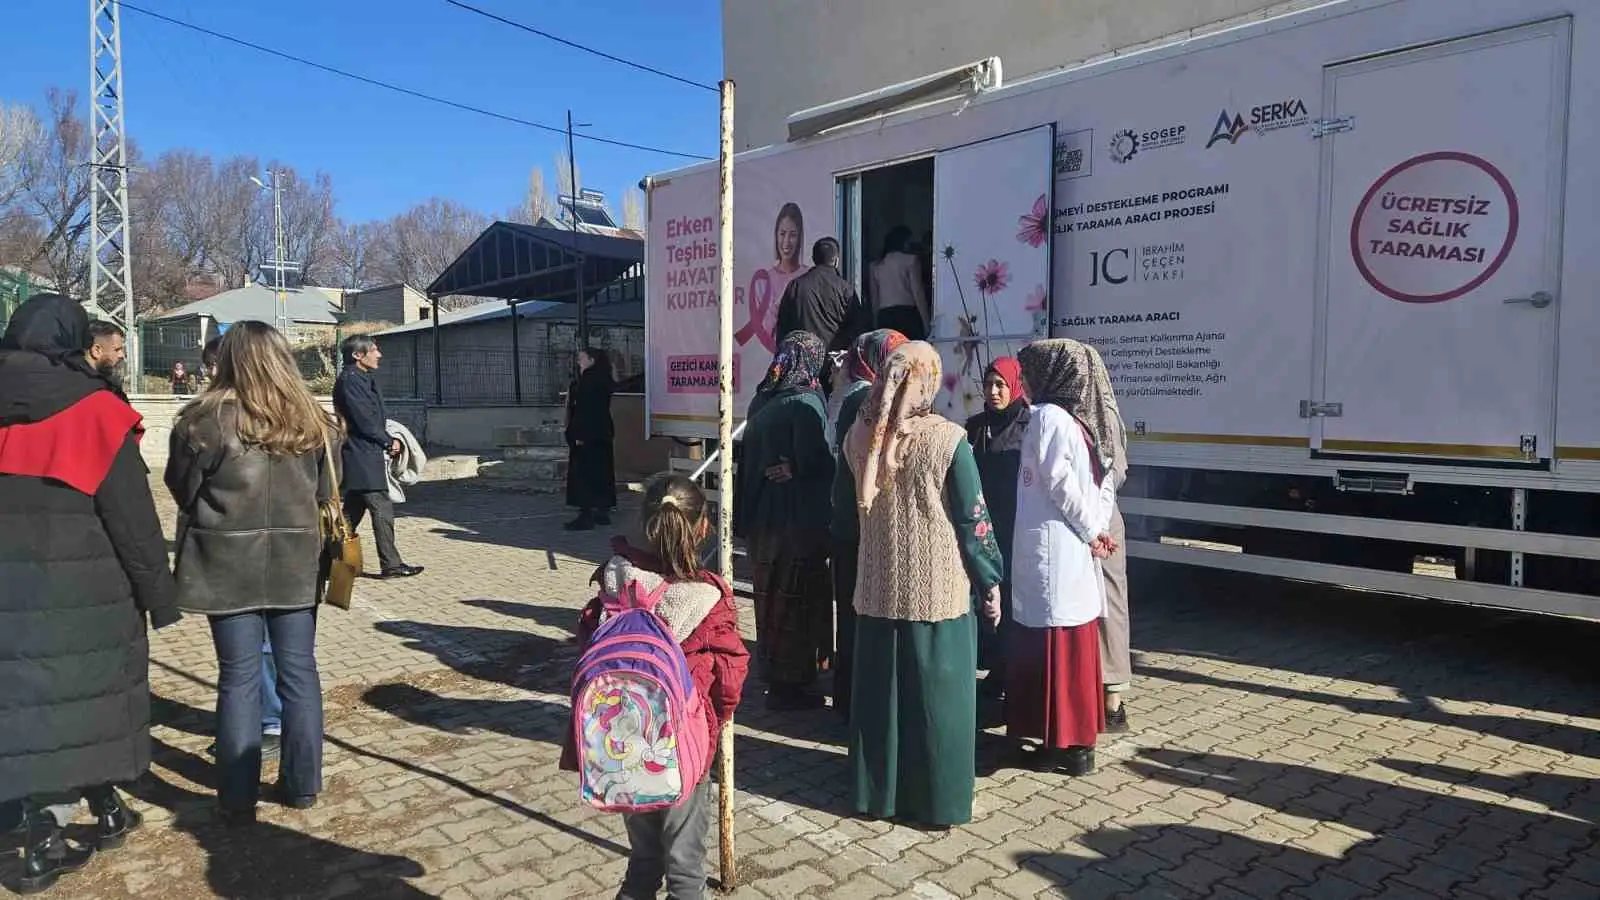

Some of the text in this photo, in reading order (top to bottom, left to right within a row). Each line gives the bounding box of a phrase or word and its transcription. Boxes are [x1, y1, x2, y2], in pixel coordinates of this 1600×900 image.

[1251, 98, 1307, 124] SERKA
[1142, 126, 1185, 142] SOGEP
[1087, 194, 1159, 213] DESTEKLEME
[1162, 184, 1229, 202] PROGRAMI
[1381, 192, 1491, 216] ÜCRETSİZ
[666, 216, 713, 238] Erken
[1076, 217, 1122, 231] TARAMA
[1125, 211, 1161, 225] ARACI
[1164, 201, 1215, 219] PROJESİ
[1387, 216, 1471, 238] SAĞLIK
[666, 238, 717, 267] Teşhis
[1369, 240, 1486, 263] TARAMASI
[1142, 256, 1185, 271] ÇEÇEN
[667, 266, 717, 288] HAYAT
[667, 286, 745, 310] KURTAR
[1062, 314, 1095, 327] SAĞLIK
[1098, 313, 1143, 325] TARAMA
[1145, 312, 1180, 322] ARACI
[1134, 360, 1174, 371] Teknoloji
[670, 375, 706, 387] TARAMA
